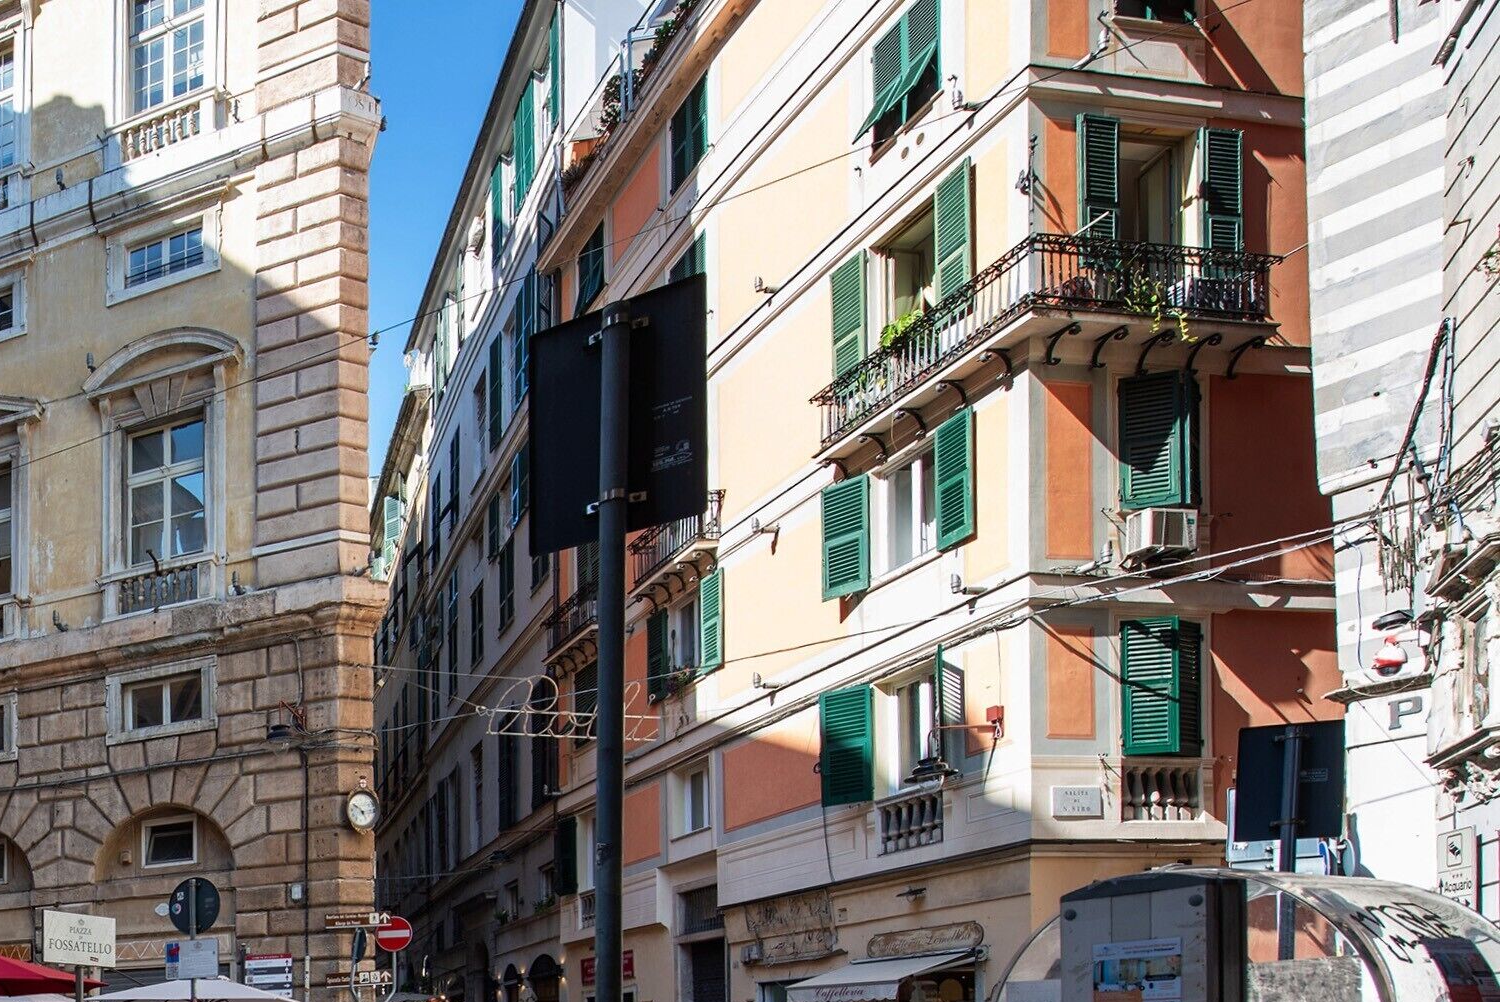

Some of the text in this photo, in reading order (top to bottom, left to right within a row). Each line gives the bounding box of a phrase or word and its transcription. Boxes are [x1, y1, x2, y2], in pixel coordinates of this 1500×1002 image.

[1387, 695, 1431, 731] P
[1444, 878, 1473, 893] Acquario
[69, 926, 92, 936] PIAZZA
[48, 938, 112, 955] FOSSATELLO
